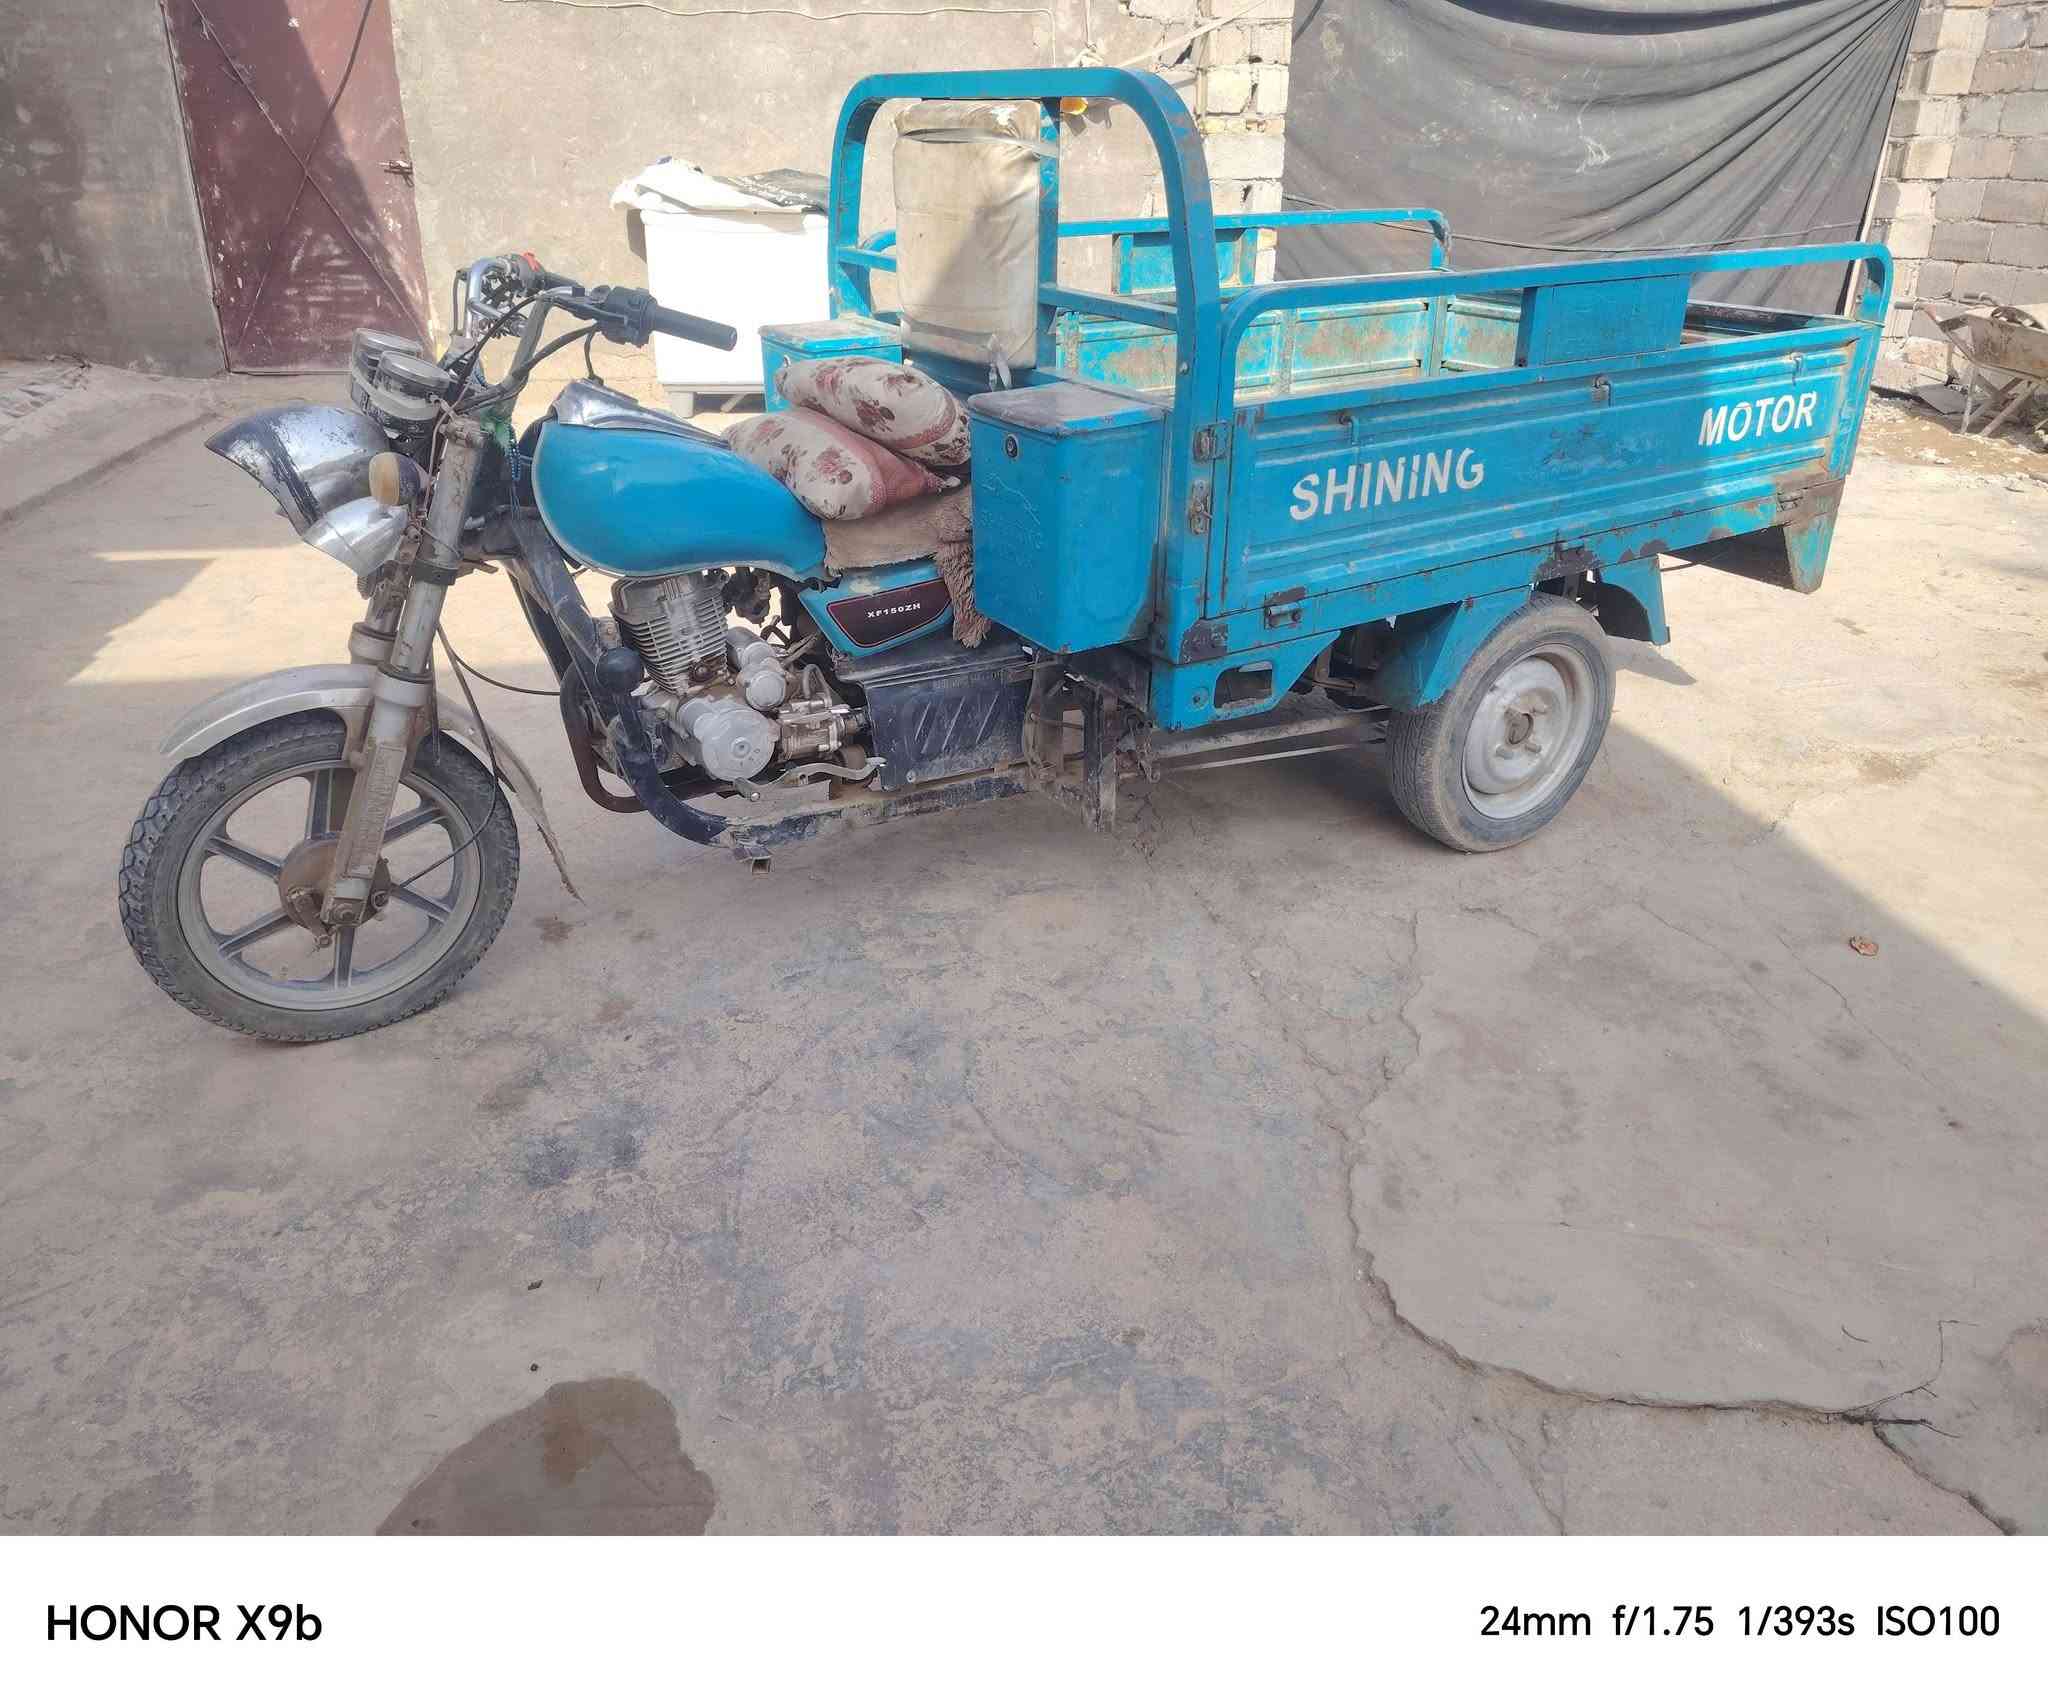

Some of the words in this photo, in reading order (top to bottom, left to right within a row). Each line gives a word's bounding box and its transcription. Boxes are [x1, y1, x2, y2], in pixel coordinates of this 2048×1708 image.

[1289, 447, 1485, 521] SHINING
[1698, 391, 1818, 446] MOTOR
[867, 602, 921, 618] XF150ZH
